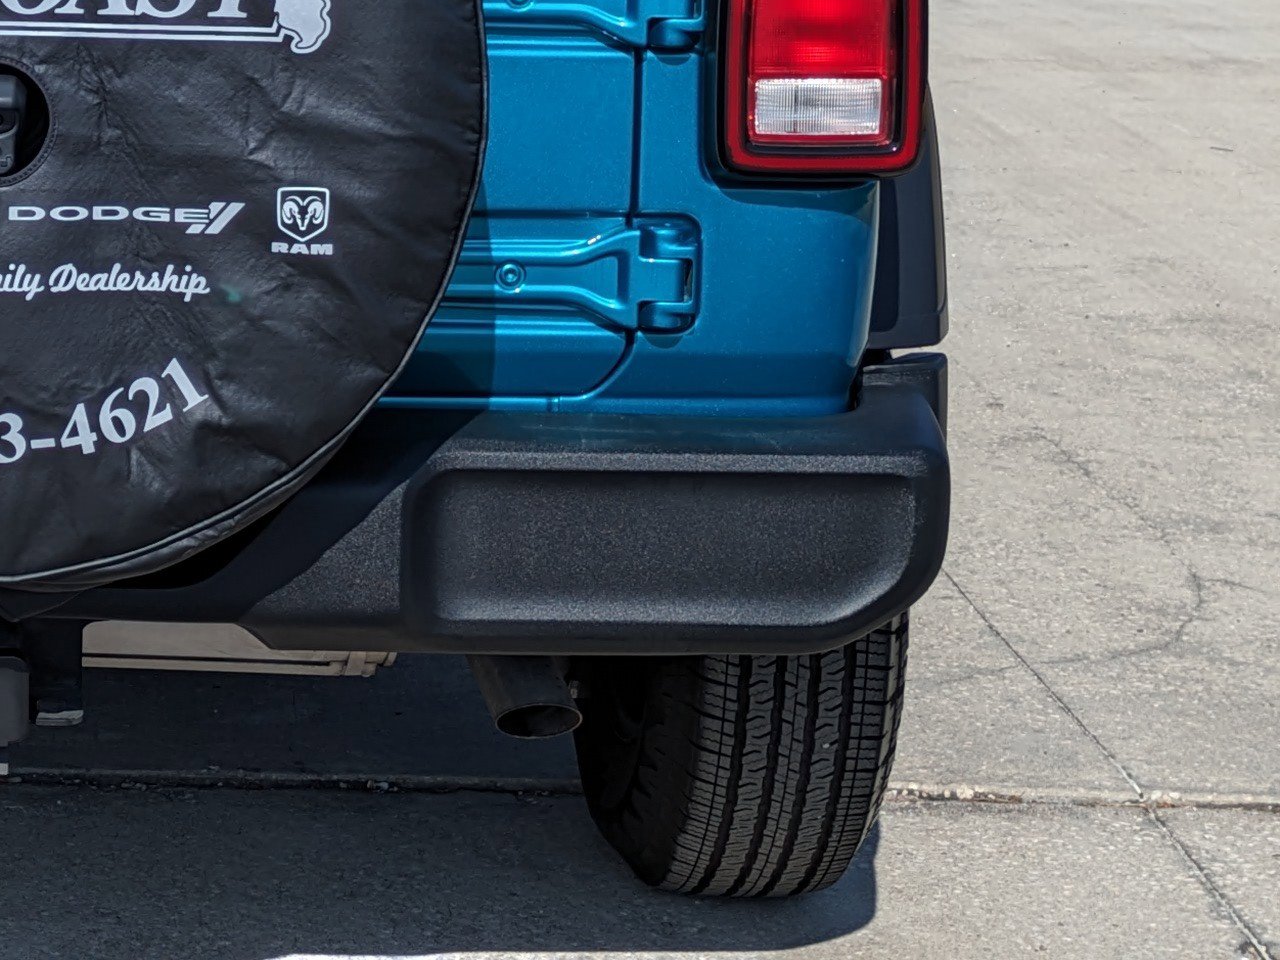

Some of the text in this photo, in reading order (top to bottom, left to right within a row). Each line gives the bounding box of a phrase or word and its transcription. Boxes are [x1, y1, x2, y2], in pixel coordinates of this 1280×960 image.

[8, 205, 211, 223] DODGE
[271, 242, 333, 256] RAM
[48, 262, 211, 302] Dealership
